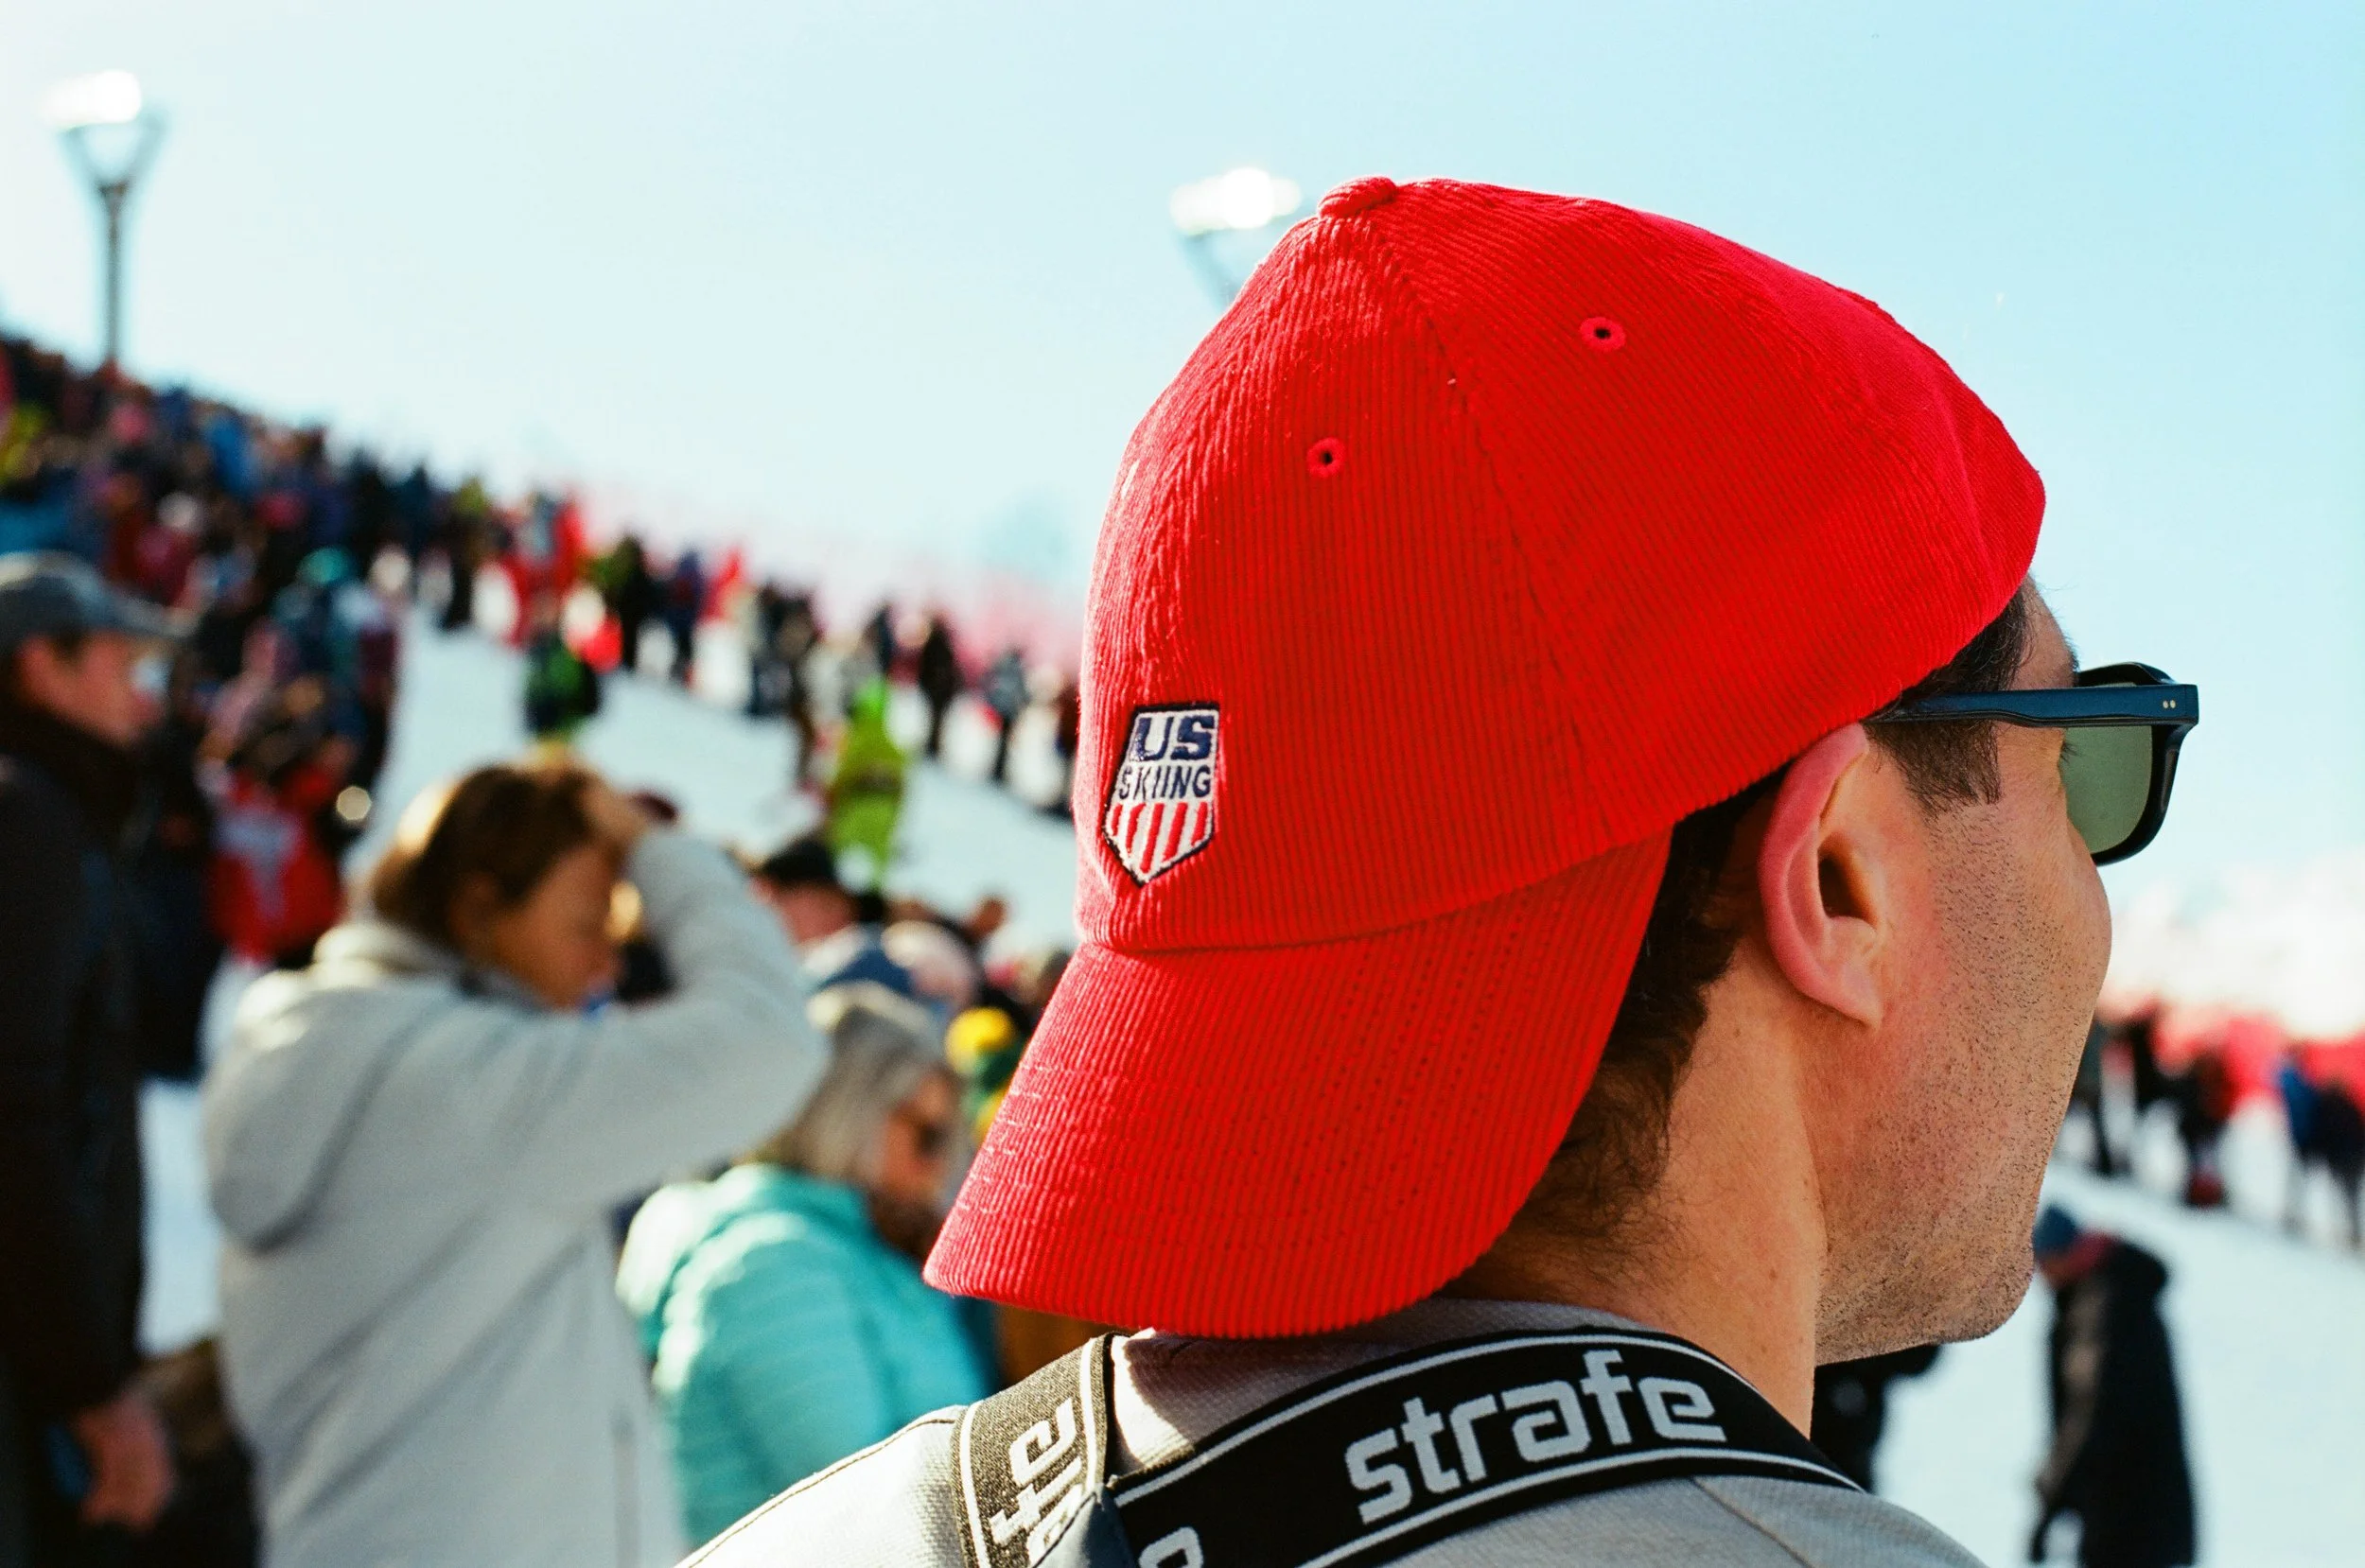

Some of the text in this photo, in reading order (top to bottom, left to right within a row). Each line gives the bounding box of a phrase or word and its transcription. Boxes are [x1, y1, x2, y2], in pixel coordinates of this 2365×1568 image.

[1136, 715, 1215, 761] US
[1118, 763, 1212, 800] SKIING
[1343, 1349, 1727, 1525] strafe
